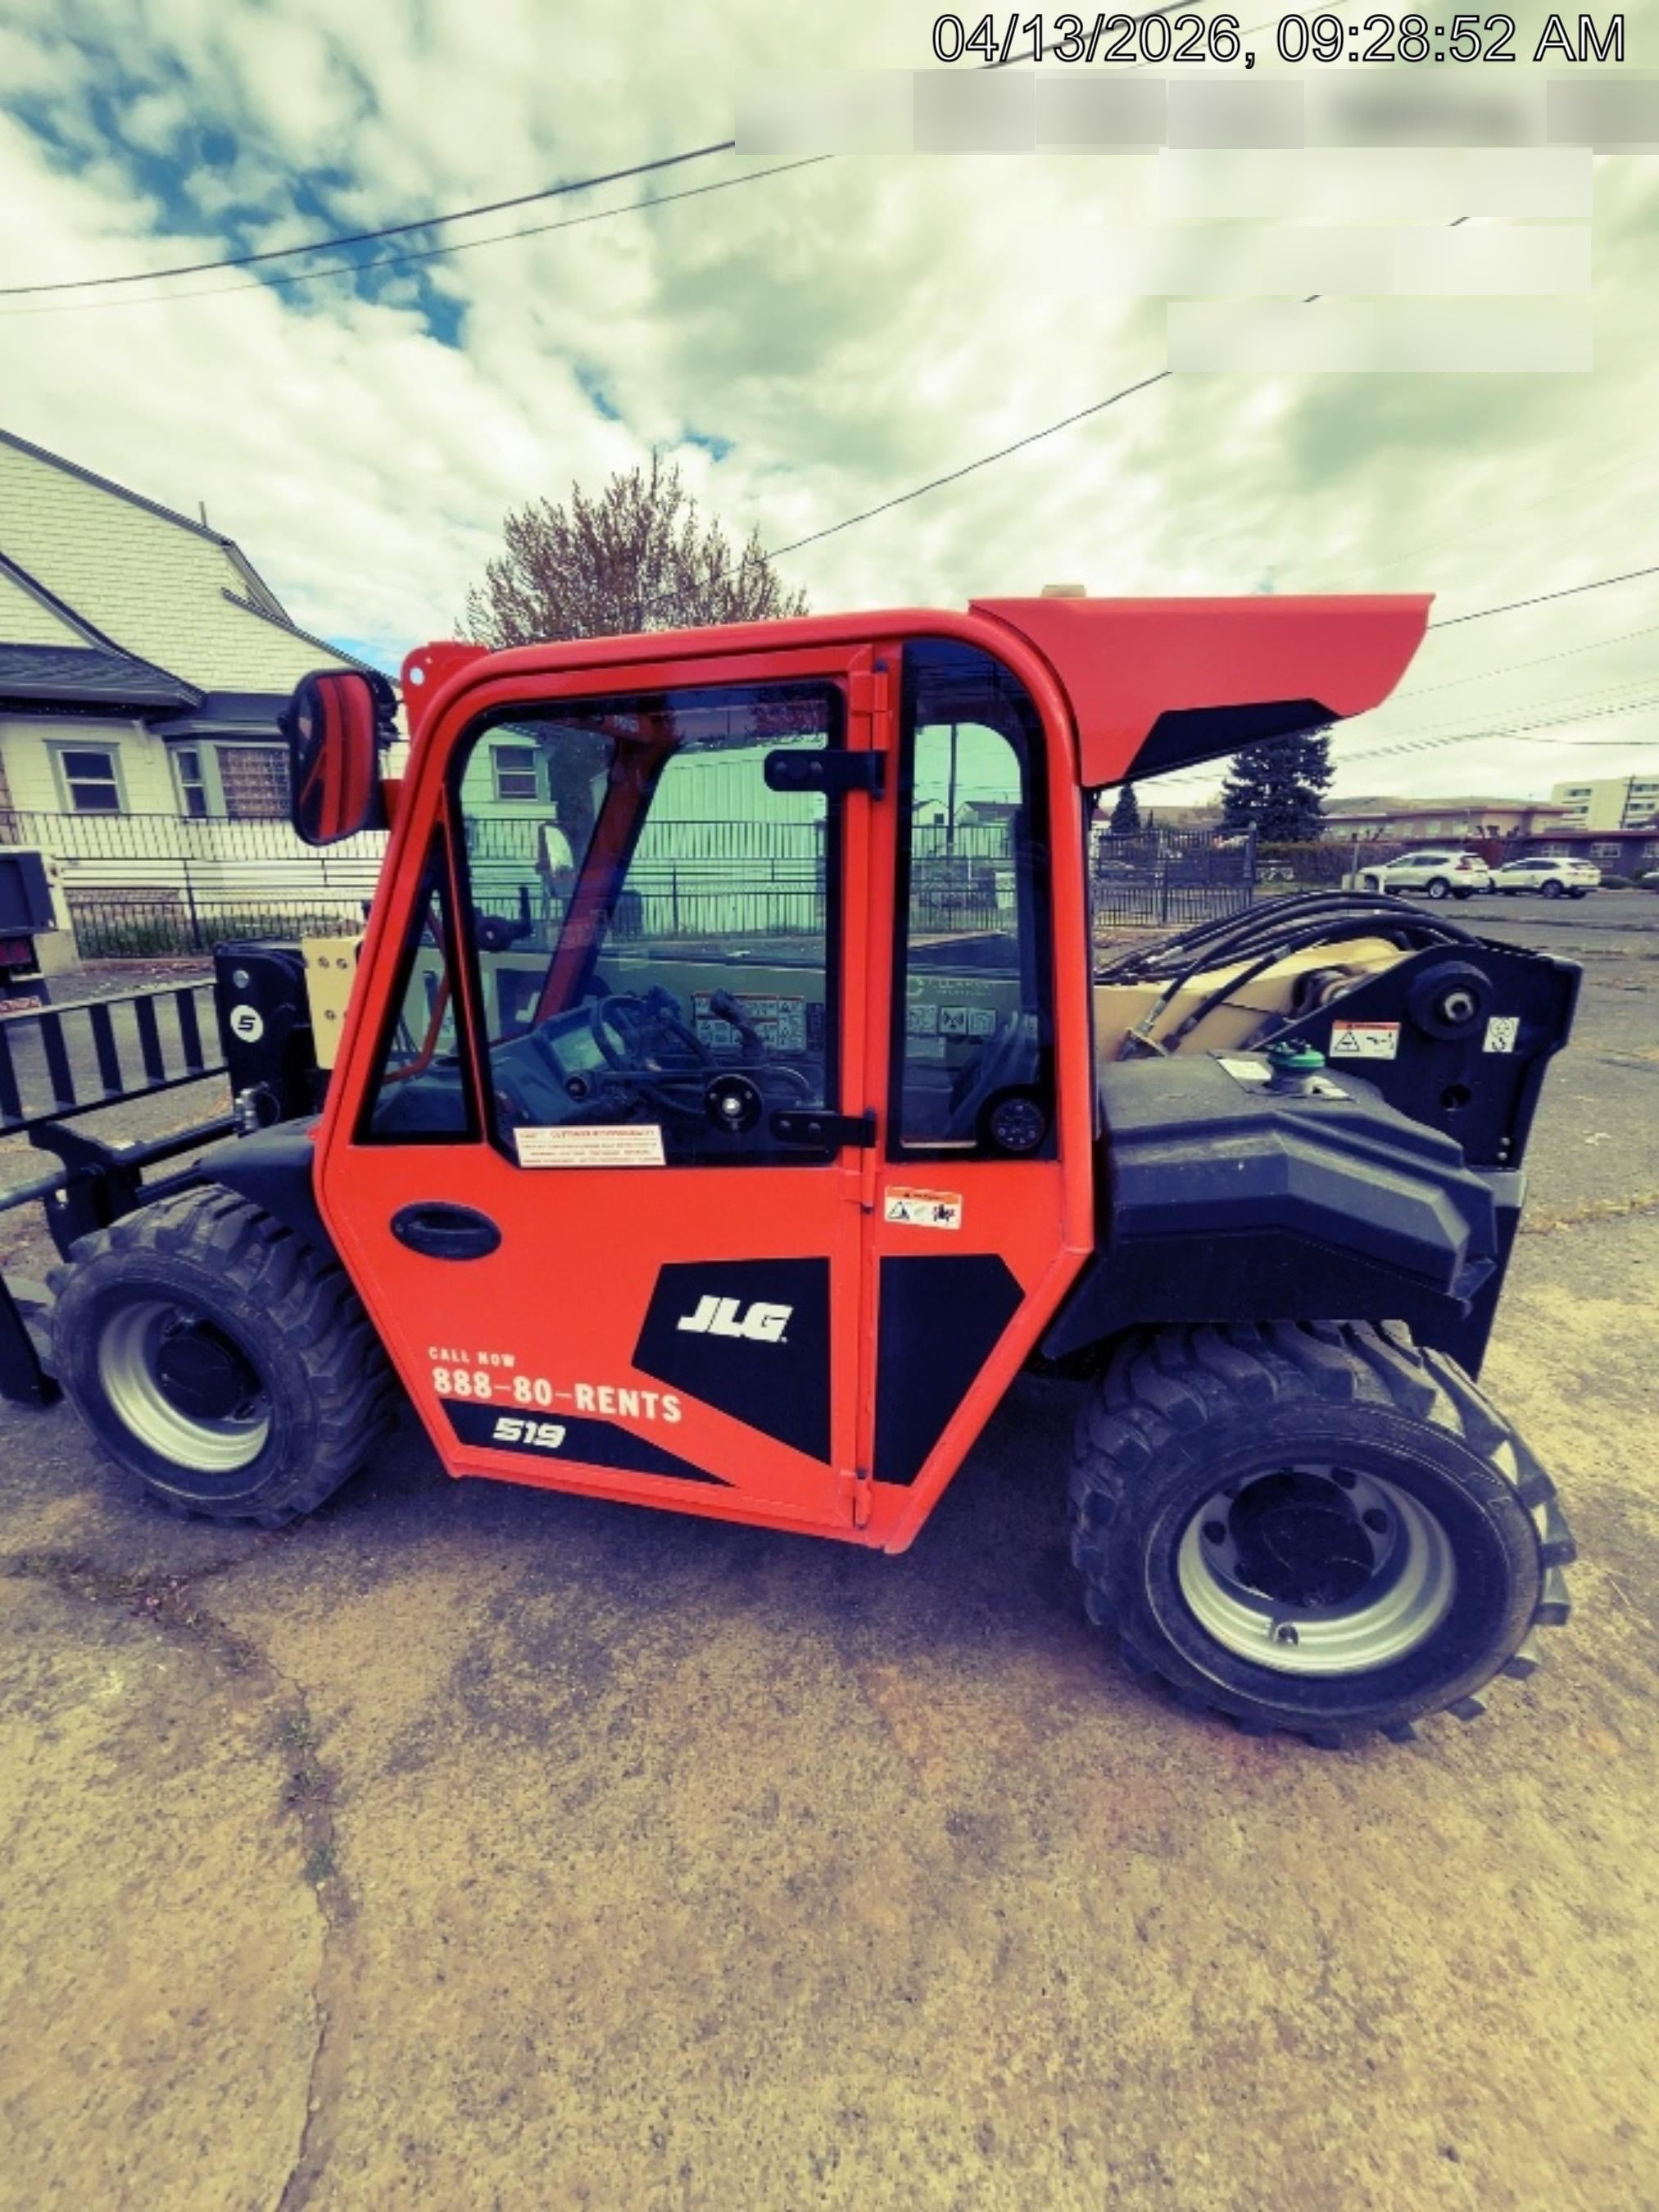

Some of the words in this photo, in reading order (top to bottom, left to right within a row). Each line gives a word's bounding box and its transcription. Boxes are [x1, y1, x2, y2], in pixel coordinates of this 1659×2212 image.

[676, 1294, 795, 1344] JLG
[428, 1346, 470, 1363] CALL
[478, 1352, 516, 1367] NOW
[432, 1367, 682, 1423] 888-80-RENTS
[492, 1416, 566, 1448] 519
